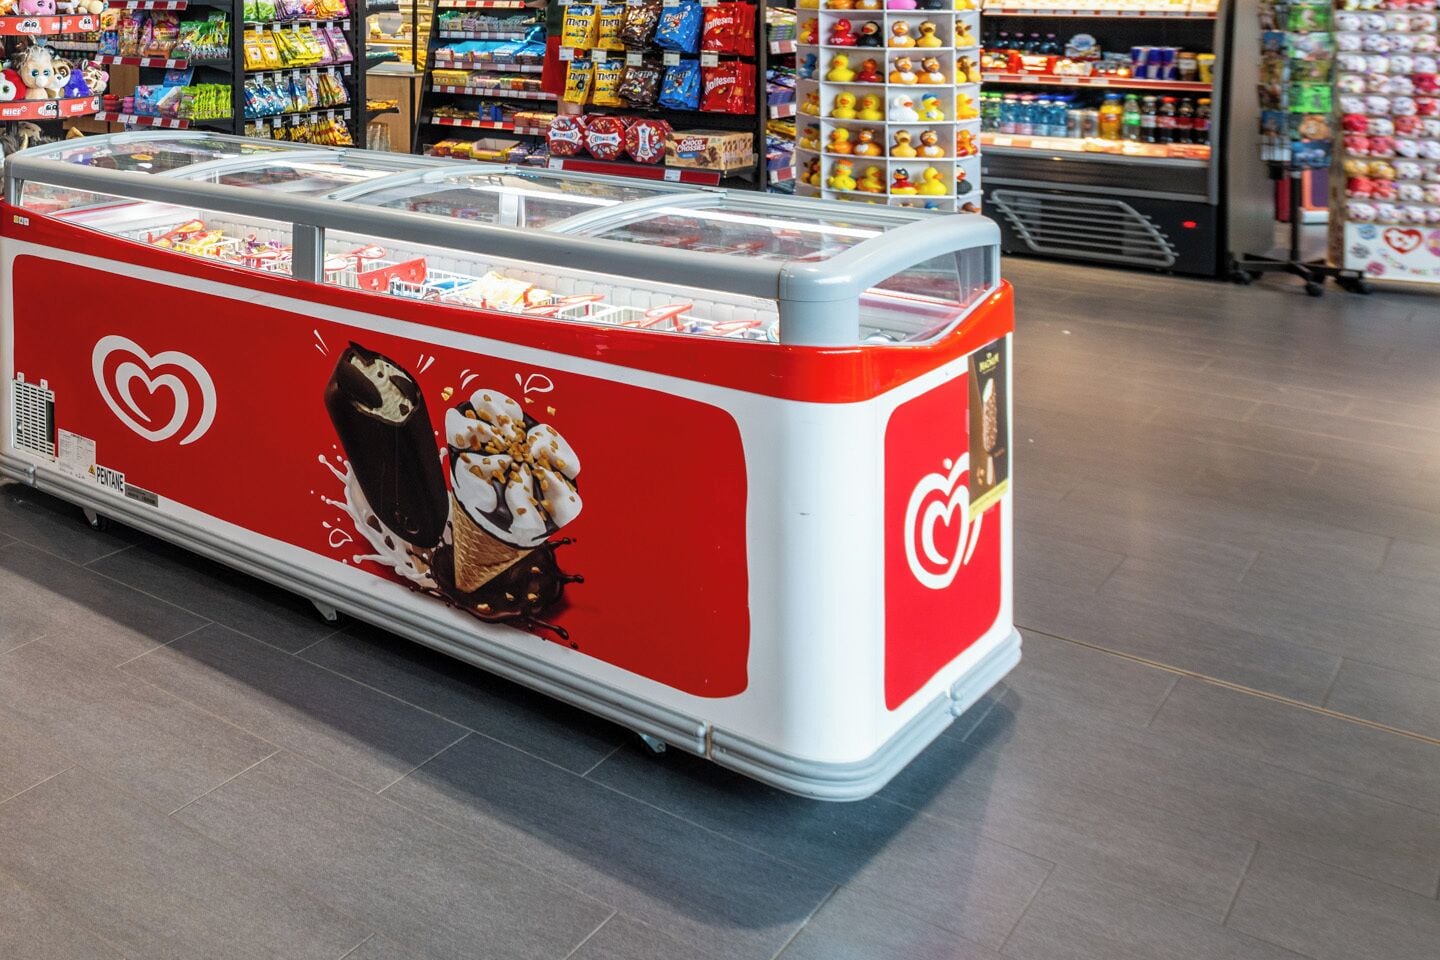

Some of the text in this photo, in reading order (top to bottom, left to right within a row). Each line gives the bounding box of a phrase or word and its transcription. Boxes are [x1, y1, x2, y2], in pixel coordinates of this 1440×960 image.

[681, 138, 703, 147] CHOCO
[676, 144, 706, 153] CROSSIES
[96, 466, 124, 492] PENTANE
